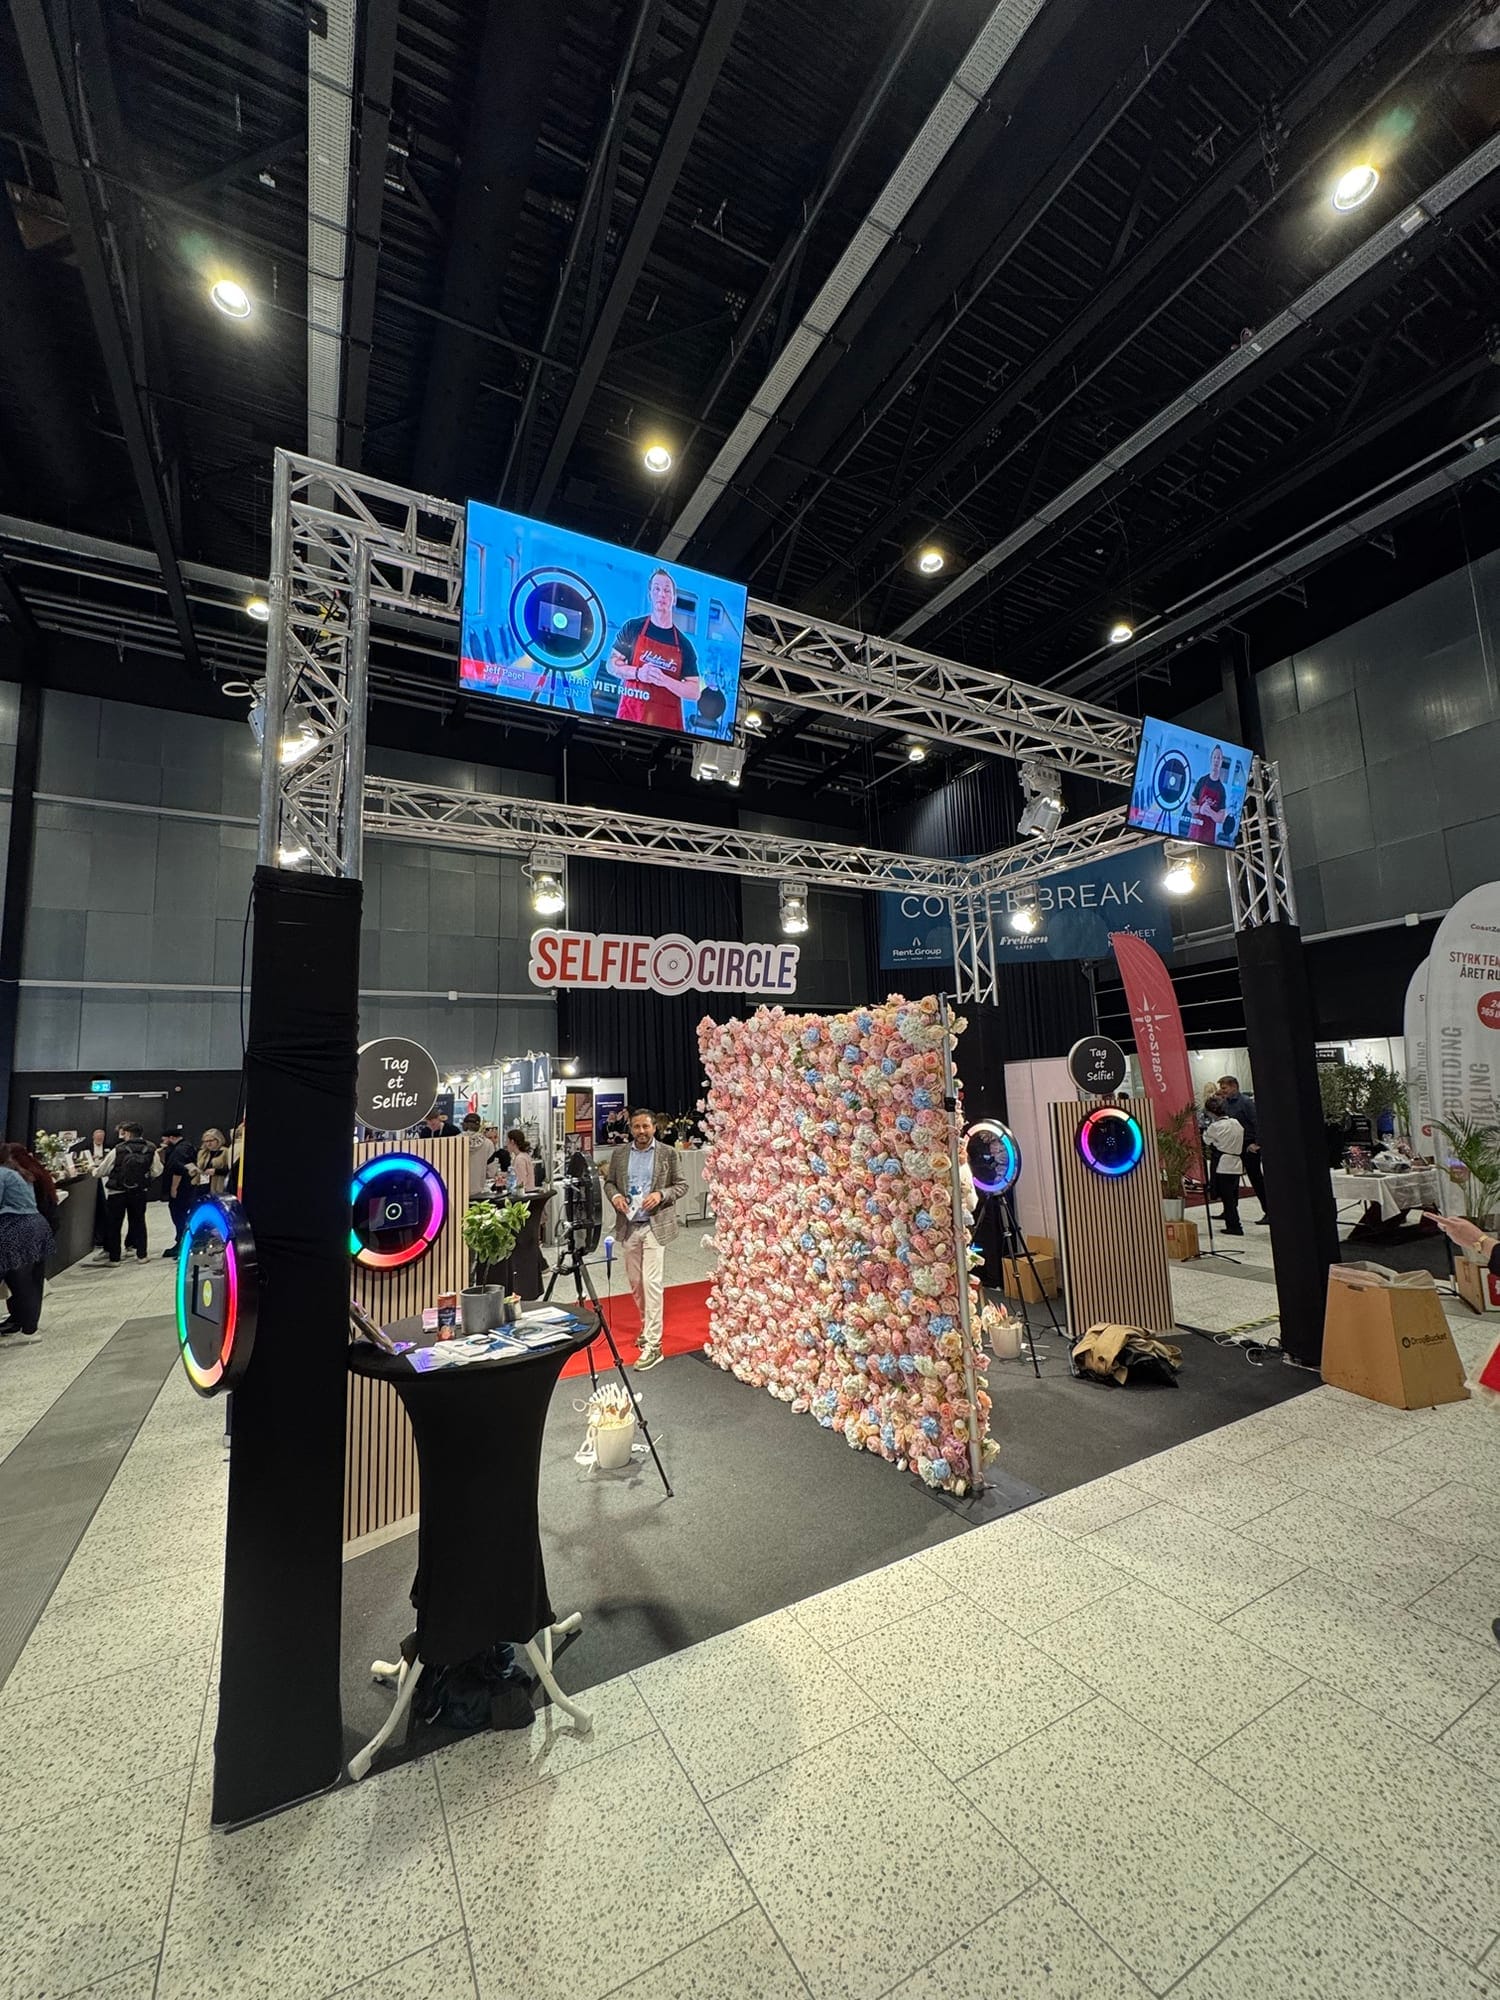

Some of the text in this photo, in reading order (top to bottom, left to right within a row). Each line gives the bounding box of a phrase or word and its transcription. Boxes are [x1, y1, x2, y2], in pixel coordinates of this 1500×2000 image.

[617, 684, 650, 701] RIGTIG
[900, 880, 1143, 919] COEE BREAK
[1000, 935, 1048, 946] Frellsen
[536, 937, 795, 988] SELFIE CIRCLE
[1449, 951, 1481, 965] STYRK
[1460, 964, 1485, 979] ÅRET
[1089, 1048, 1107, 1059] Tag
[380, 1057, 409, 1073] Tag
[1095, 1060, 1104, 1069] et
[387, 1075, 404, 1089] et
[1087, 1070, 1114, 1081] Selfie!
[1469, 1063, 1495, 1123] IKLING
[372, 1093, 418, 1110] Selfie!
